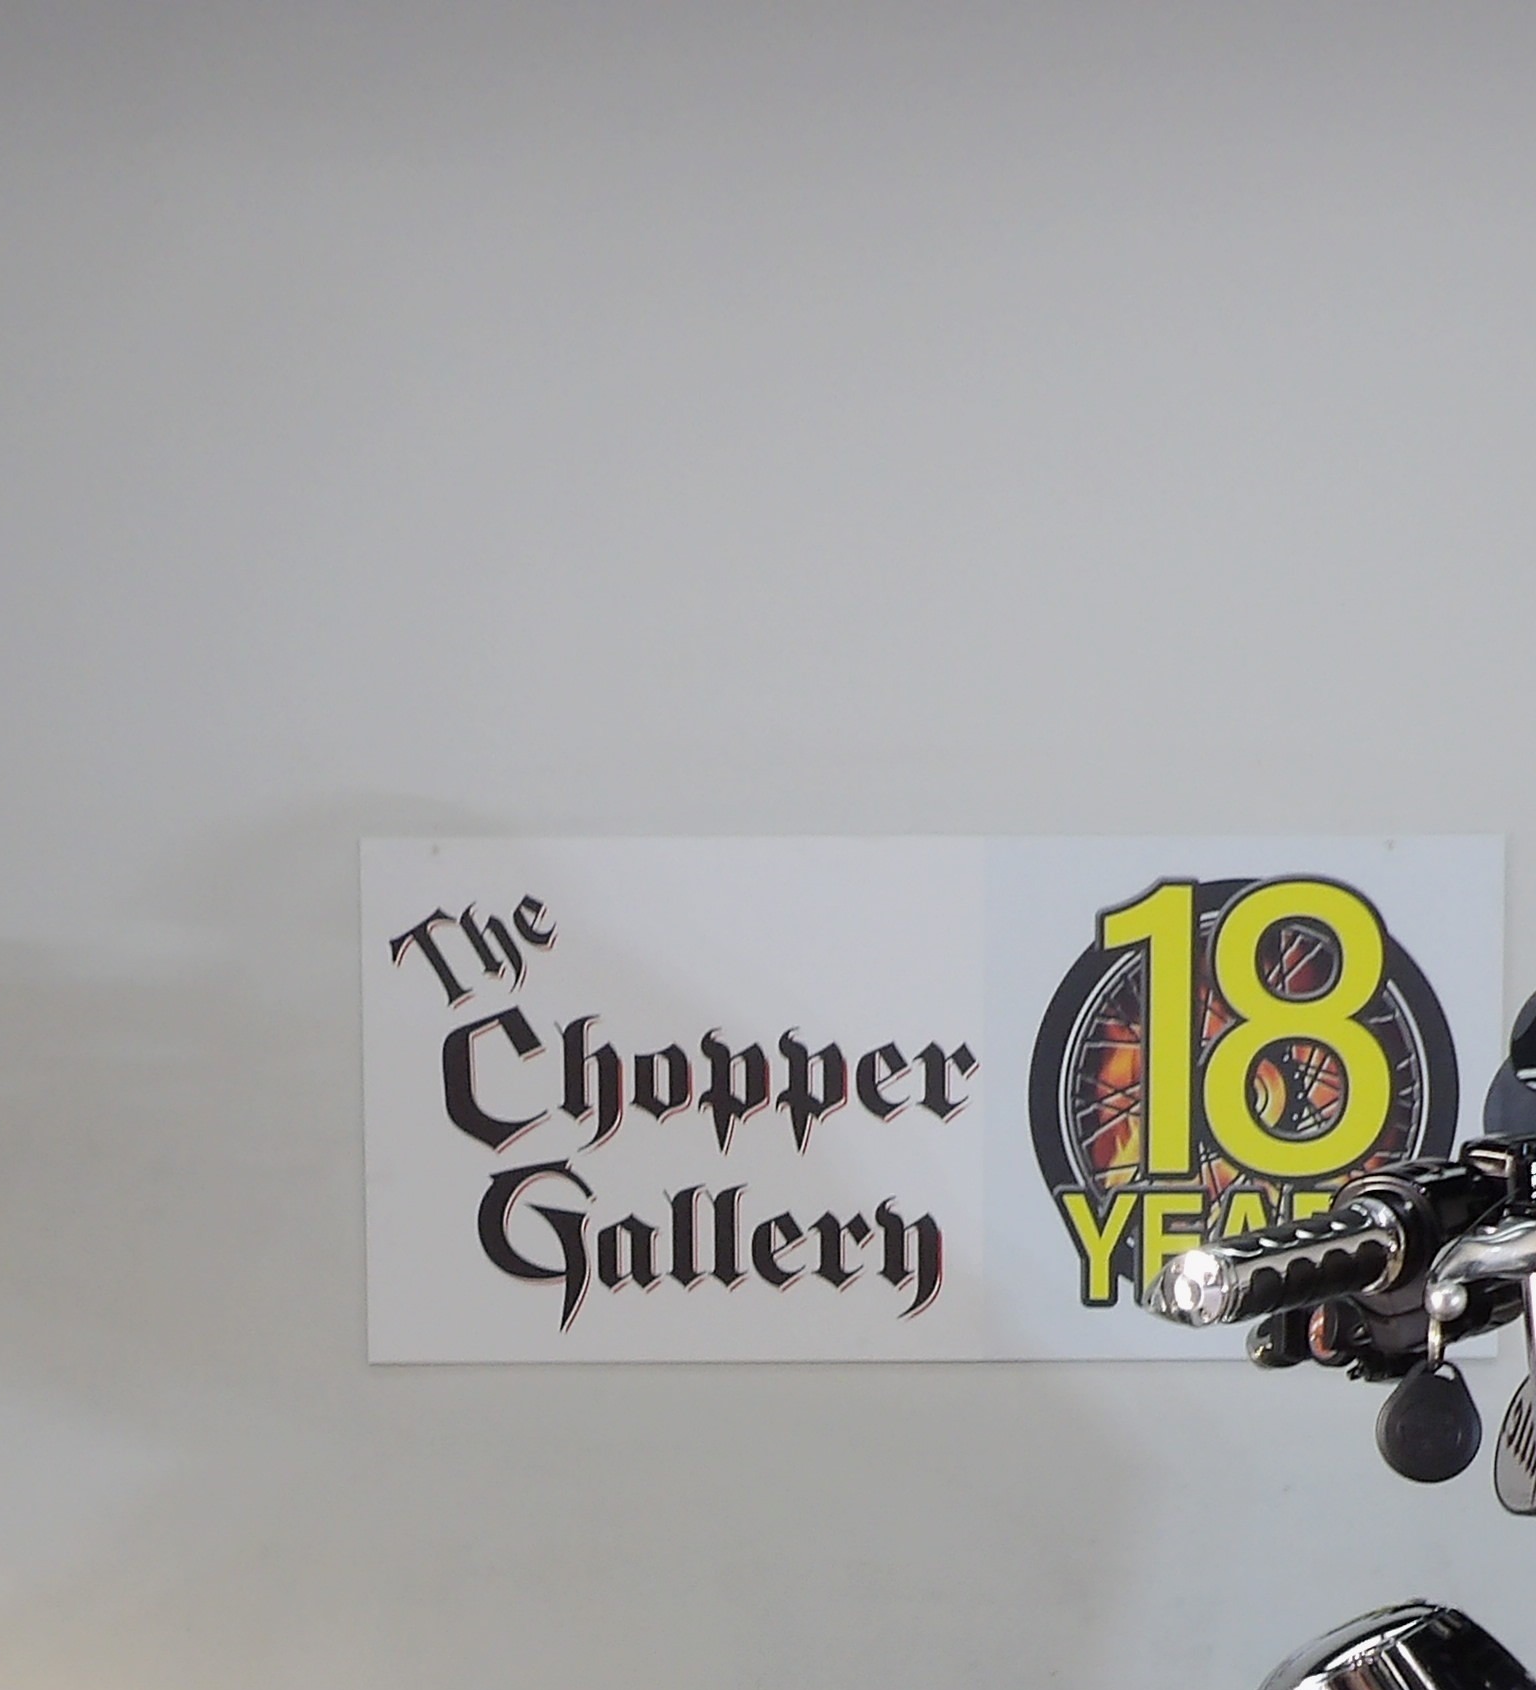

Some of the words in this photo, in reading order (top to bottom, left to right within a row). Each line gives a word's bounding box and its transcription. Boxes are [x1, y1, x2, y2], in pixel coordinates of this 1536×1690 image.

[390, 890, 558, 1007] The
[442, 1005, 980, 1154] Chopper
[1096, 875, 1394, 1181] 18
[477, 1159, 942, 1333] Gallery
[1059, 1188, 1336, 1305] YE
